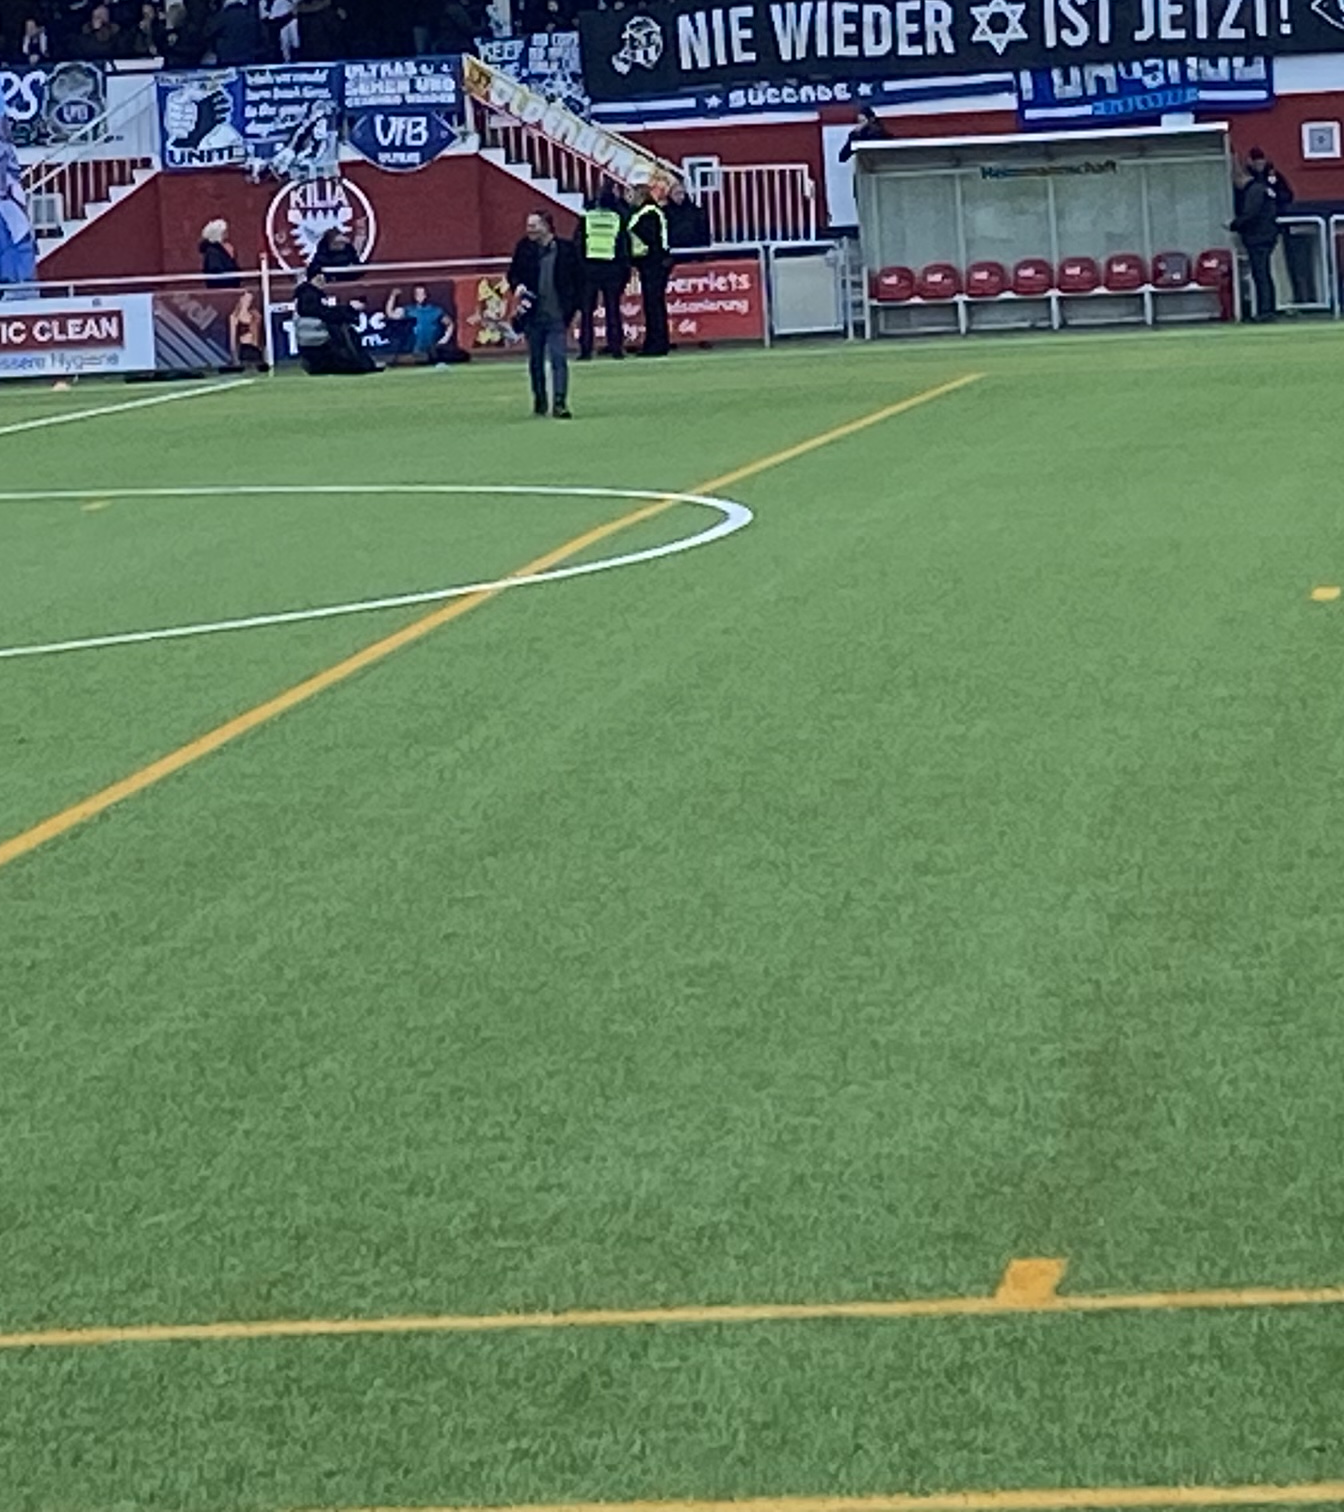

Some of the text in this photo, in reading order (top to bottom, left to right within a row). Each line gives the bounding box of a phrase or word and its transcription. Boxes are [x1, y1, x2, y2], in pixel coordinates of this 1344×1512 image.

[677, 5, 757, 71] NIE
[770, 0, 956, 62] WIEDER
[374, 113, 429, 146] VfB
[289, 180, 350, 208] KILIA
[32, 316, 120, 342] CLEAN
